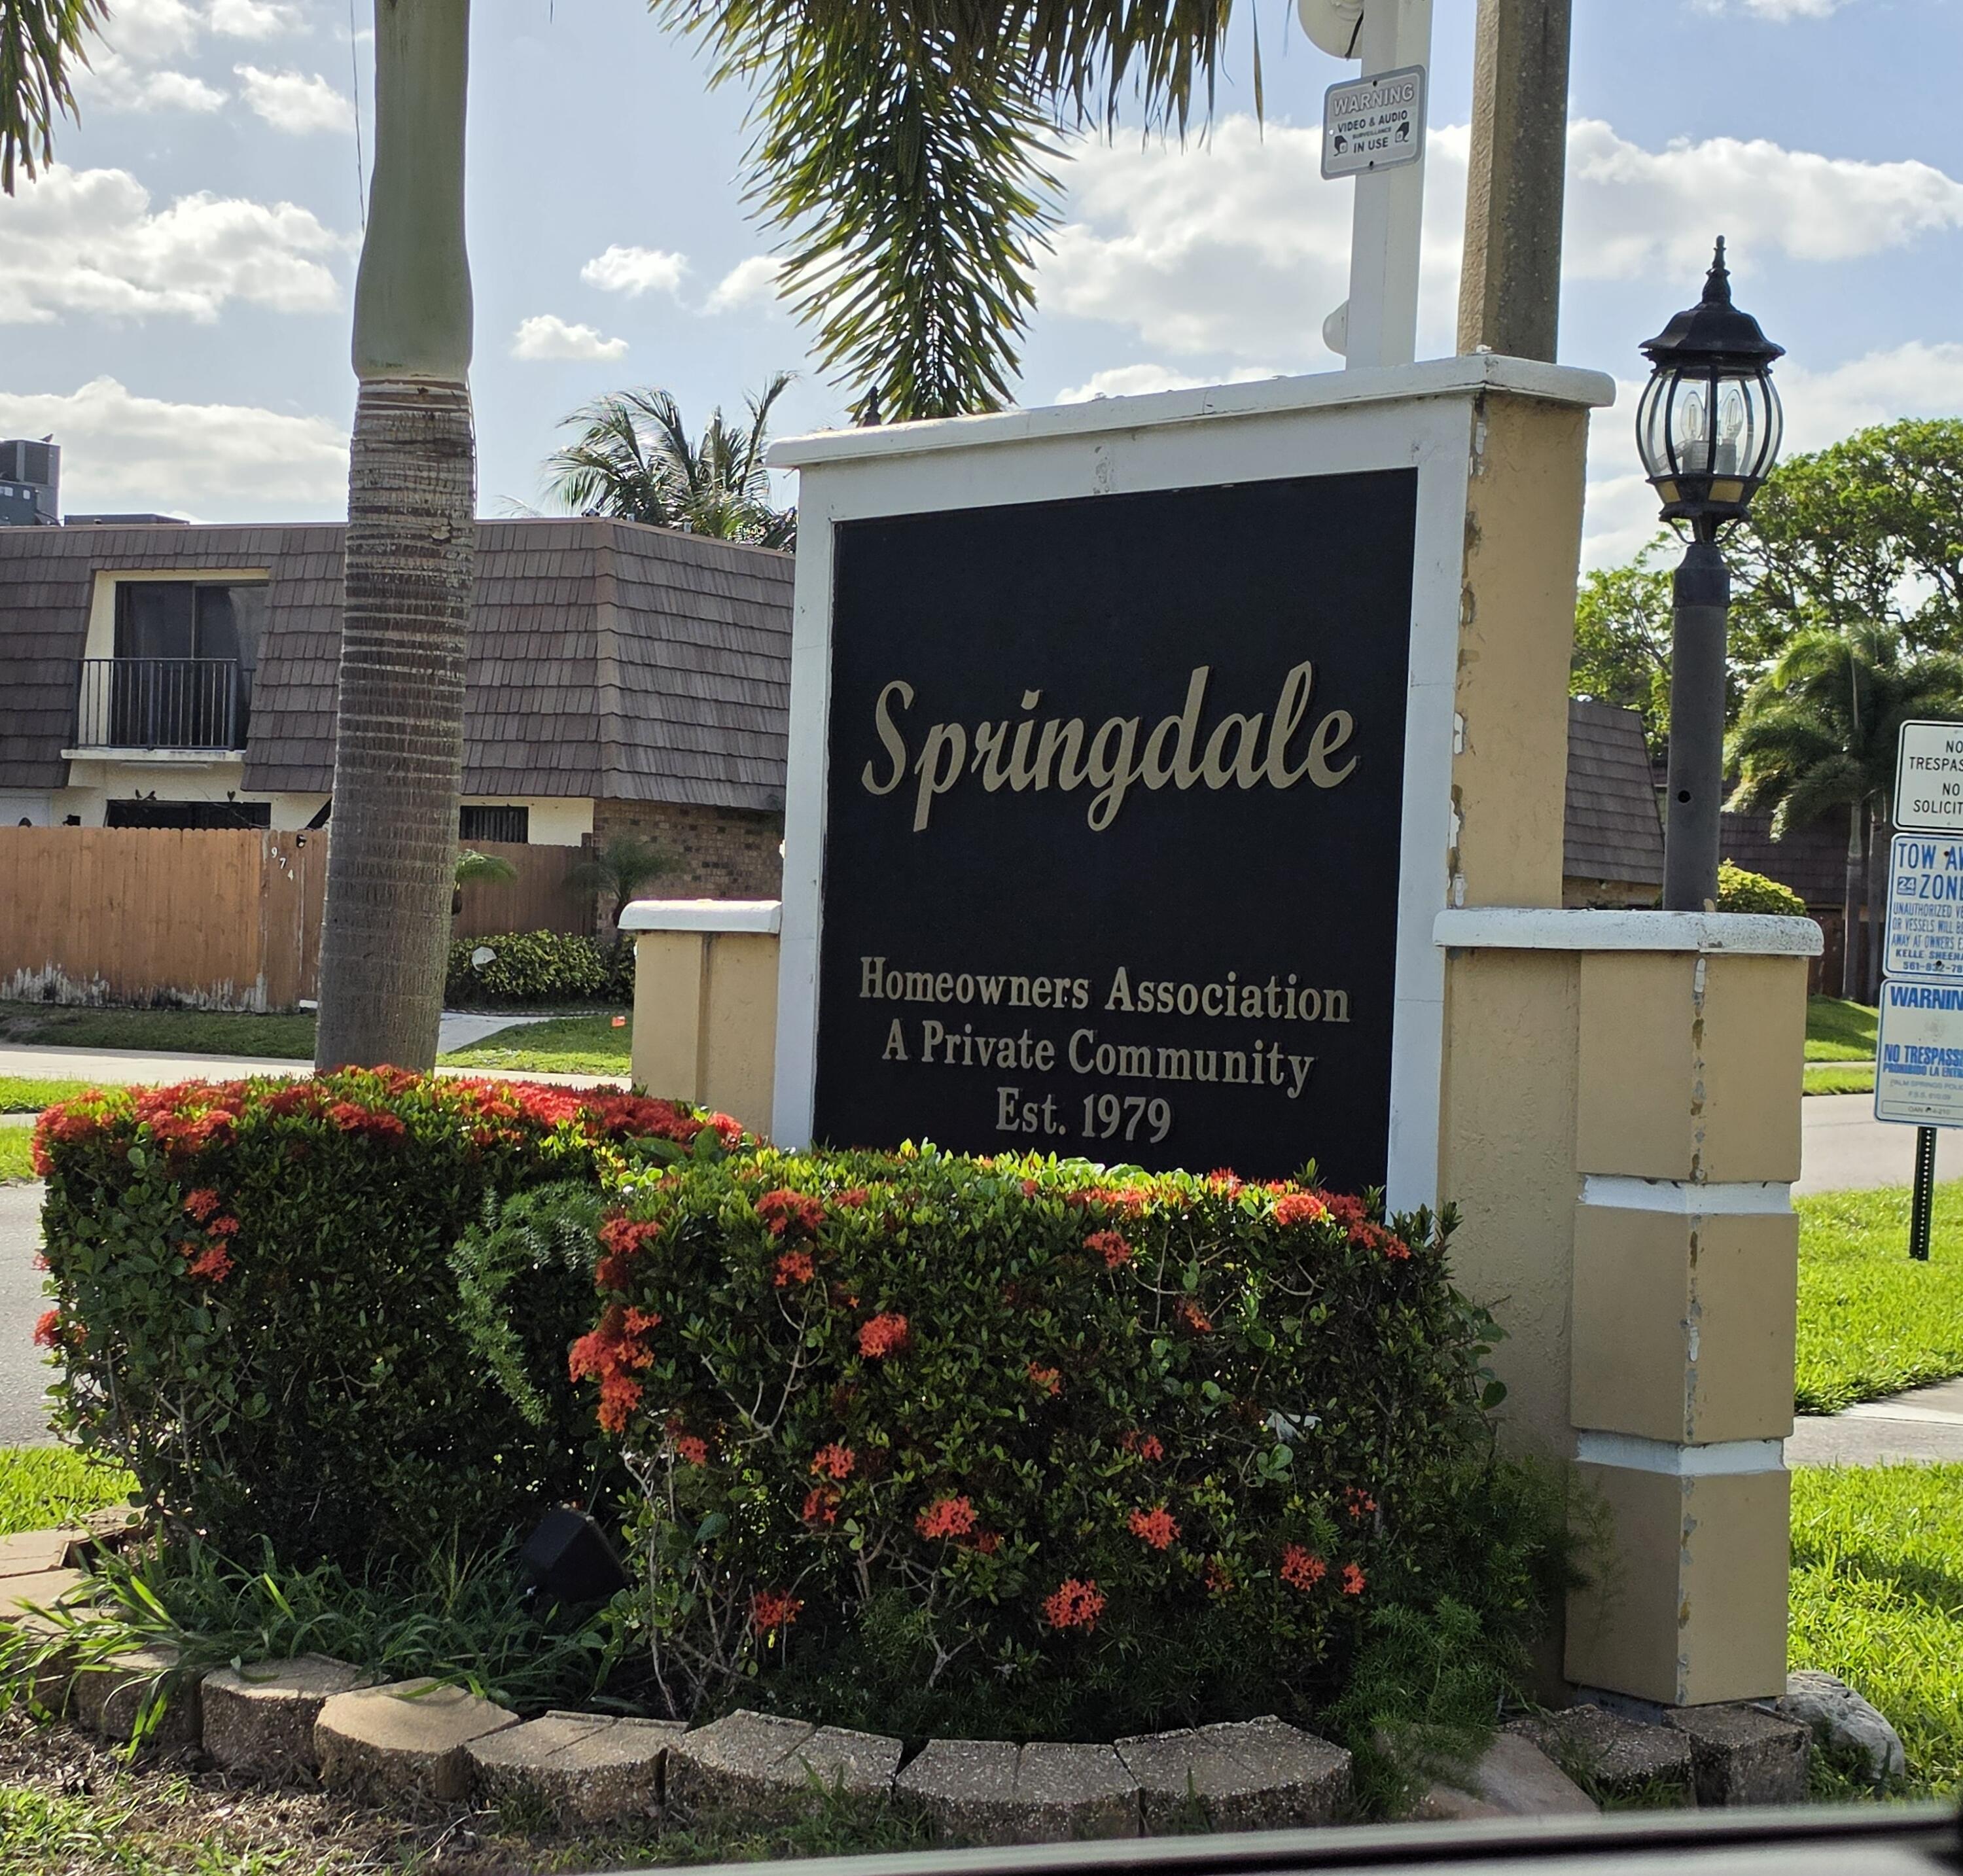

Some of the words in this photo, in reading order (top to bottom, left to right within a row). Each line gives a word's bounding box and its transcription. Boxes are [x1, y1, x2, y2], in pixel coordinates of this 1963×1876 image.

[1334, 83, 1414, 116] WARNING
[1337, 119, 1366, 133] VIDEO
[1369, 116, 1375, 127] &
[1378, 110, 1407, 125] AUDIO
[1354, 141, 1364, 153] IN
[1368, 137, 1388, 150] USE
[861, 660, 1358, 832] Springdale
[1945, 740, 1963, 753] NO
[1942, 783, 1960, 796] NO
[1913, 799, 1963, 815] SOLICIT
[1898, 843, 1936, 870] TOW
[1899, 877, 1915, 890] 24
[1893, 902, 1953, 918] UNAUTHORIZED
[1892, 917, 1901, 929] OR
[1905, 917, 1935, 932] VESSELS
[1938, 920, 1953, 934] WILL
[1891, 933, 1910, 946] AWAY
[1913, 934, 1922, 947] AT
[1924, 935, 1954, 949] OWNERS
[859, 956, 1091, 1009] Homeowners
[1104, 966, 1351, 1023] Association
[882, 1018, 909, 1061] A
[921, 1019, 1055, 1072] Private
[1068, 1028, 1315, 1099] Community
[1884, 1044, 1900, 1062] NO
[1930, 1067, 1939, 1076] LA
[996, 1086, 1066, 1136] Est.
[1081, 1094, 1171, 1144] 1979
